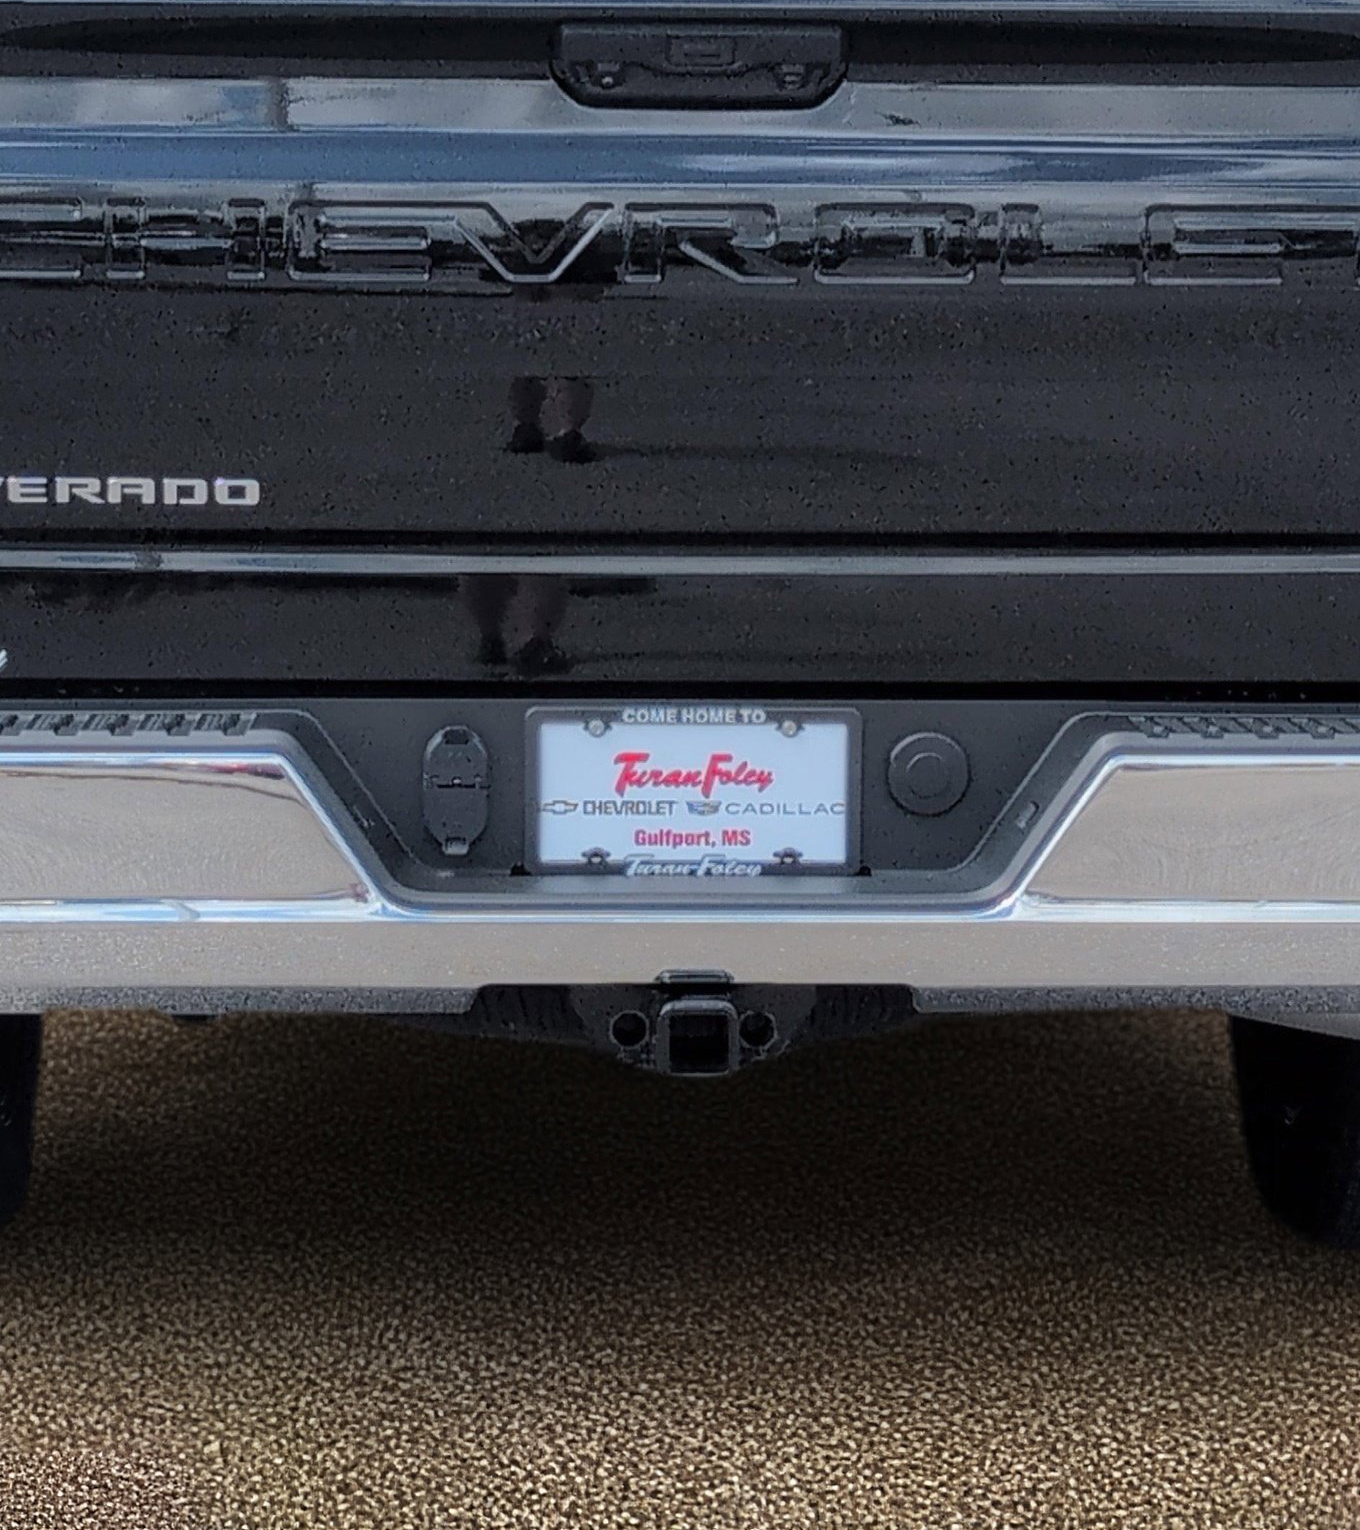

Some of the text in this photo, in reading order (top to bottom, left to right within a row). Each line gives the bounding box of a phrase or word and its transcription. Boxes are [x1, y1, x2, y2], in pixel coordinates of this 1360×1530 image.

[622, 707, 767, 724] COME HOME TO
[583, 800, 847, 816] CHEVROLET CADILLAC
[634, 829, 752, 849] Gulfport, MS
